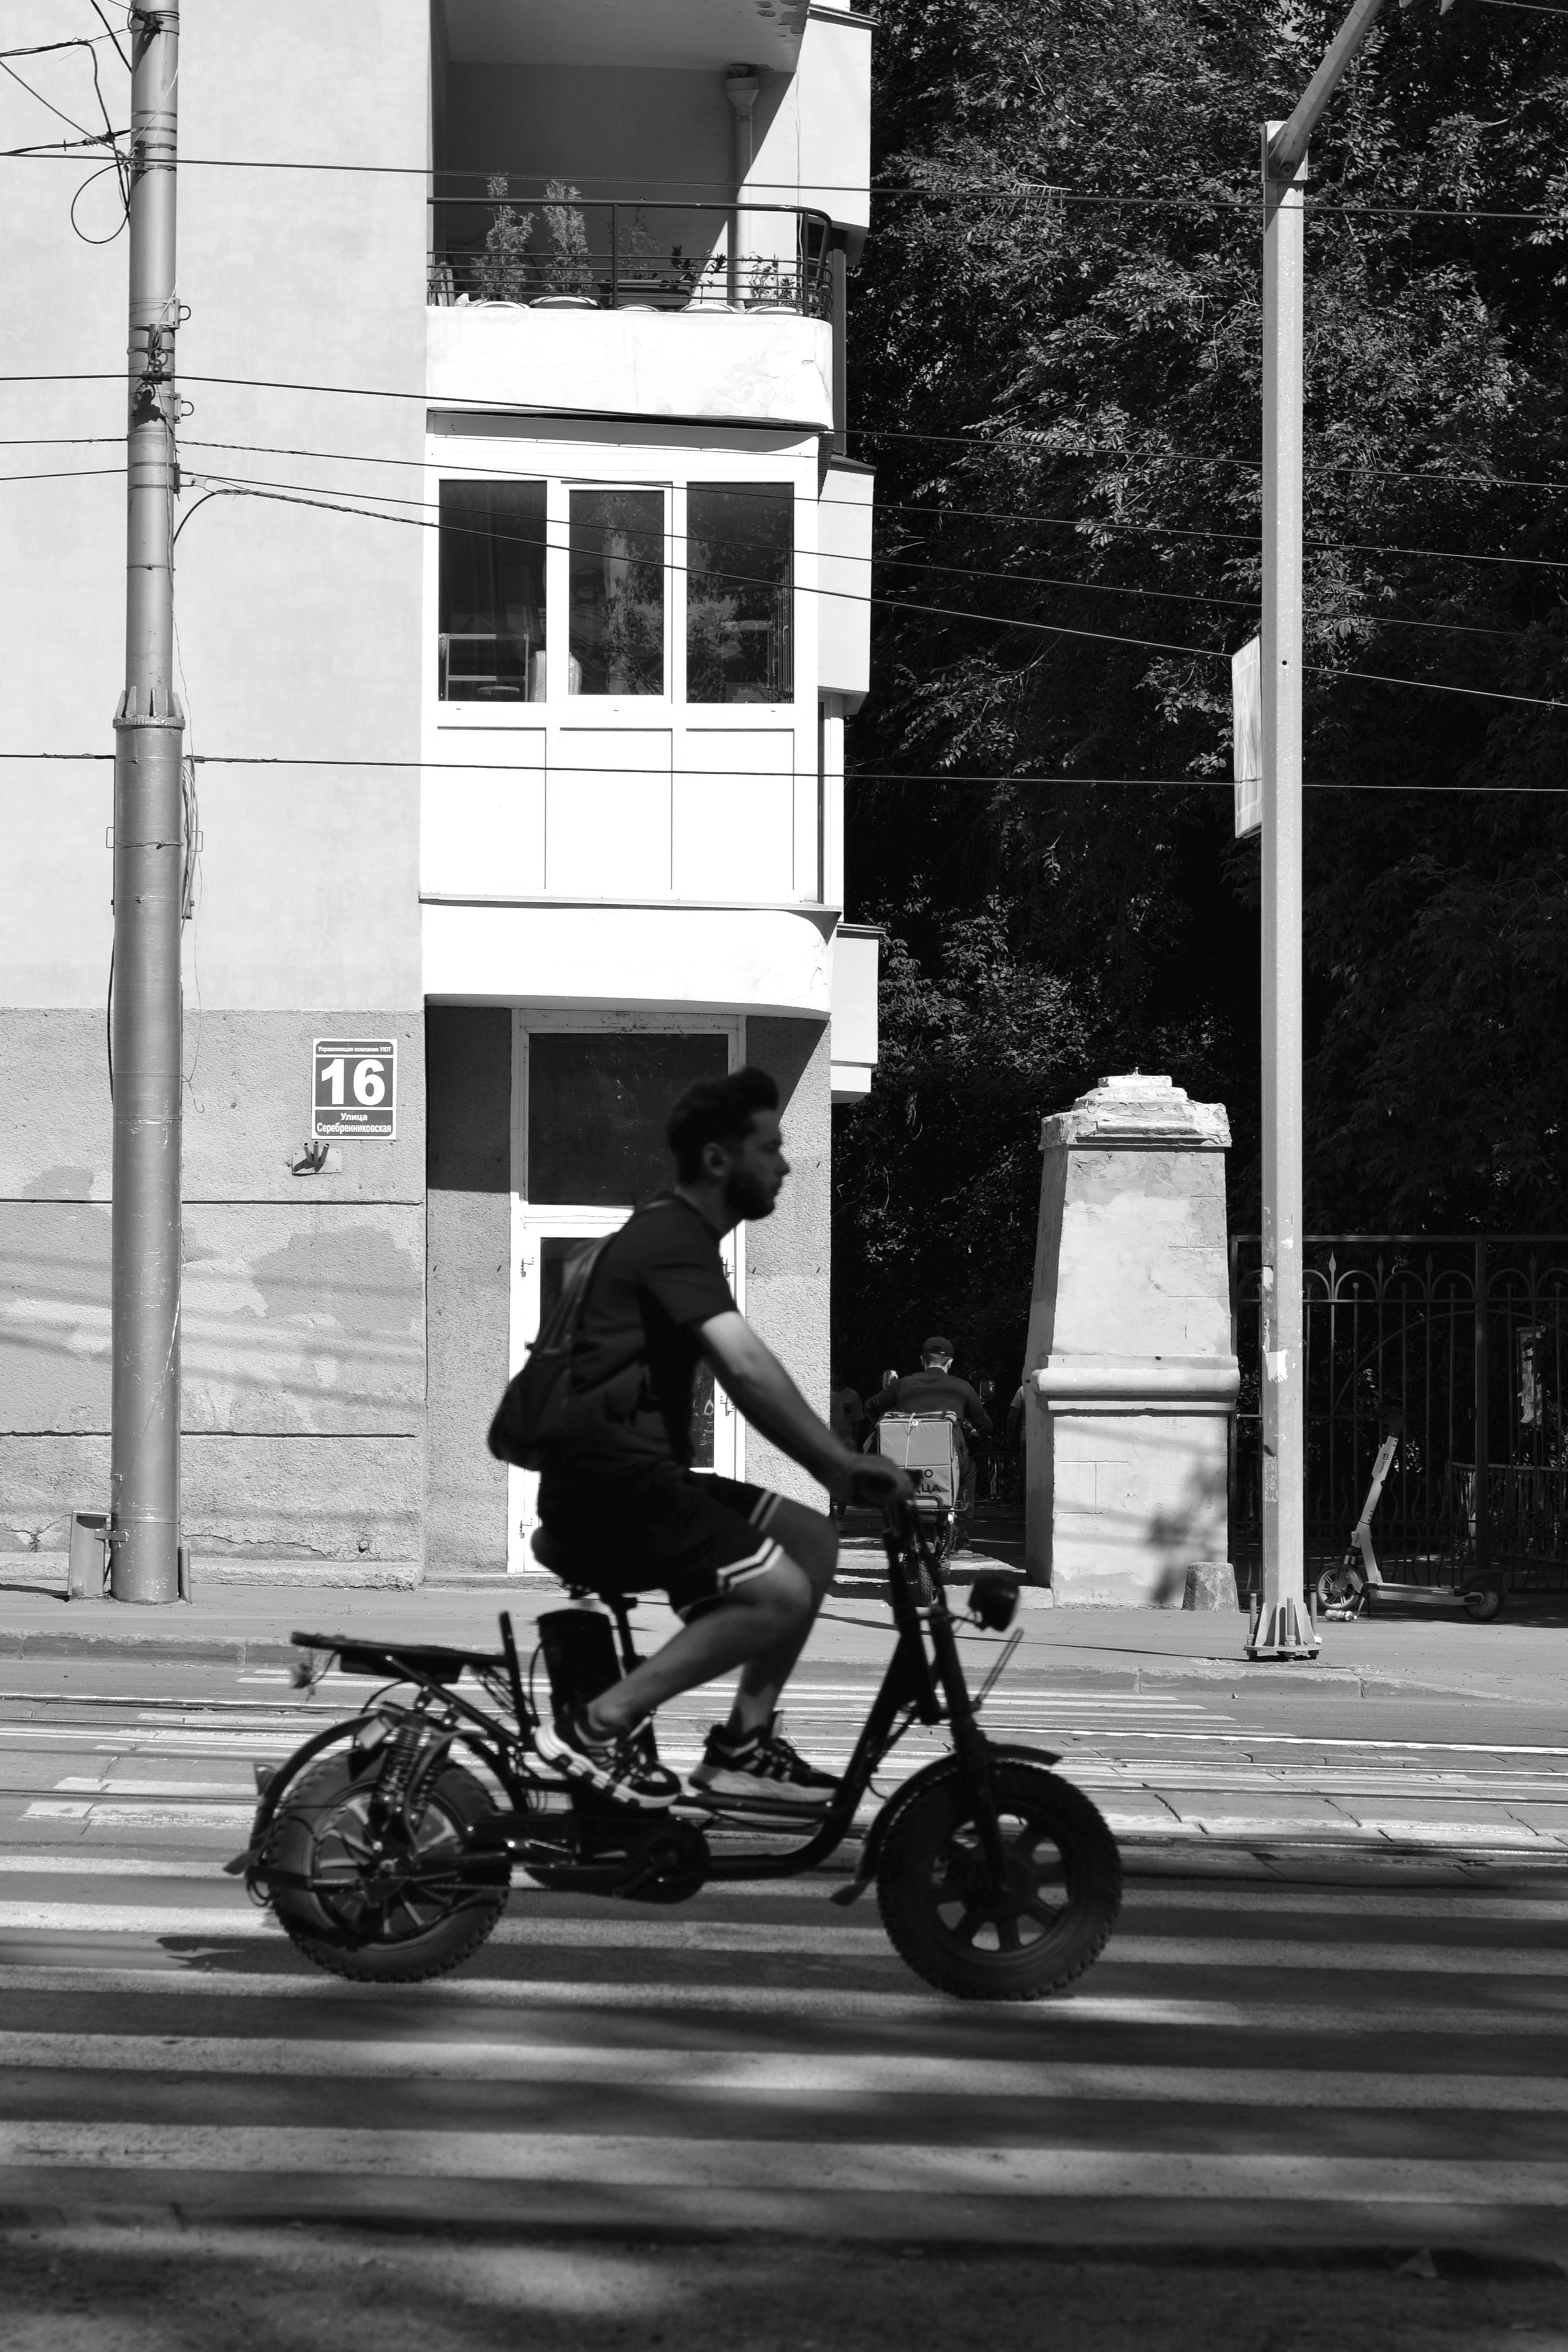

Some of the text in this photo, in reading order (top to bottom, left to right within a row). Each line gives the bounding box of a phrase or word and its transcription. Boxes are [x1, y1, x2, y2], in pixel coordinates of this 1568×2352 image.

[322, 1058, 385, 1105] 16
[341, 1113, 368, 1121] Улица
[317, 1122, 391, 1134] Серебренниковская
